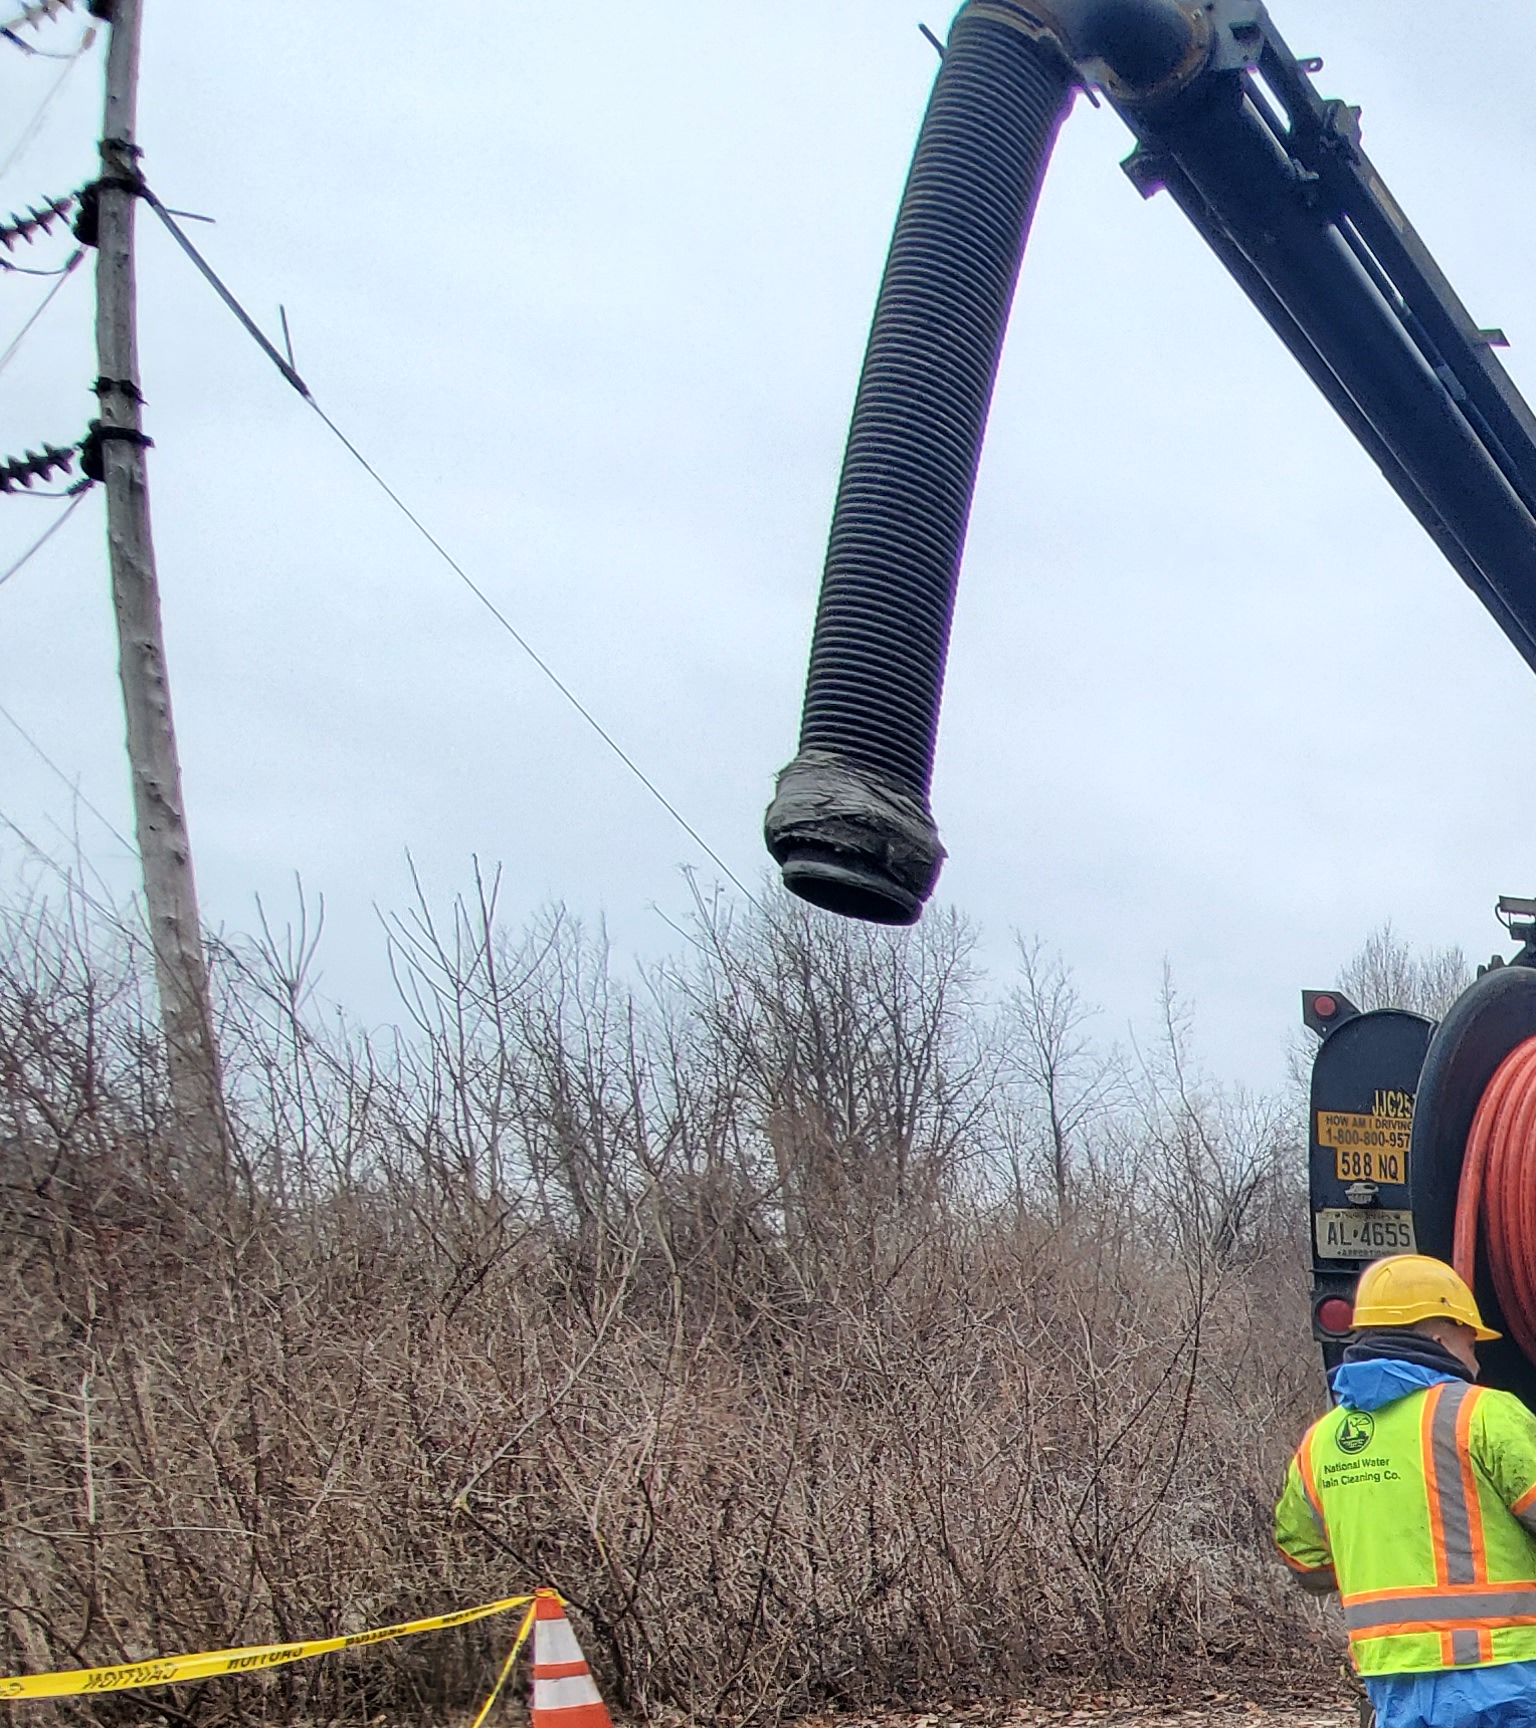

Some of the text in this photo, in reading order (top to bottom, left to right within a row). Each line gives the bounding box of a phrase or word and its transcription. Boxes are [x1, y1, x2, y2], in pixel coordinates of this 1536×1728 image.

[1325, 1115, 1349, 1127] HOW
[1352, 1117, 1366, 1129] AM
[1341, 1151, 1399, 1182] 588 NQ
[1324, 1458, 1390, 1475] National Water
[1321, 1477, 1339, 1489] ain
[1340, 1471, 1381, 1484] Cleaning
